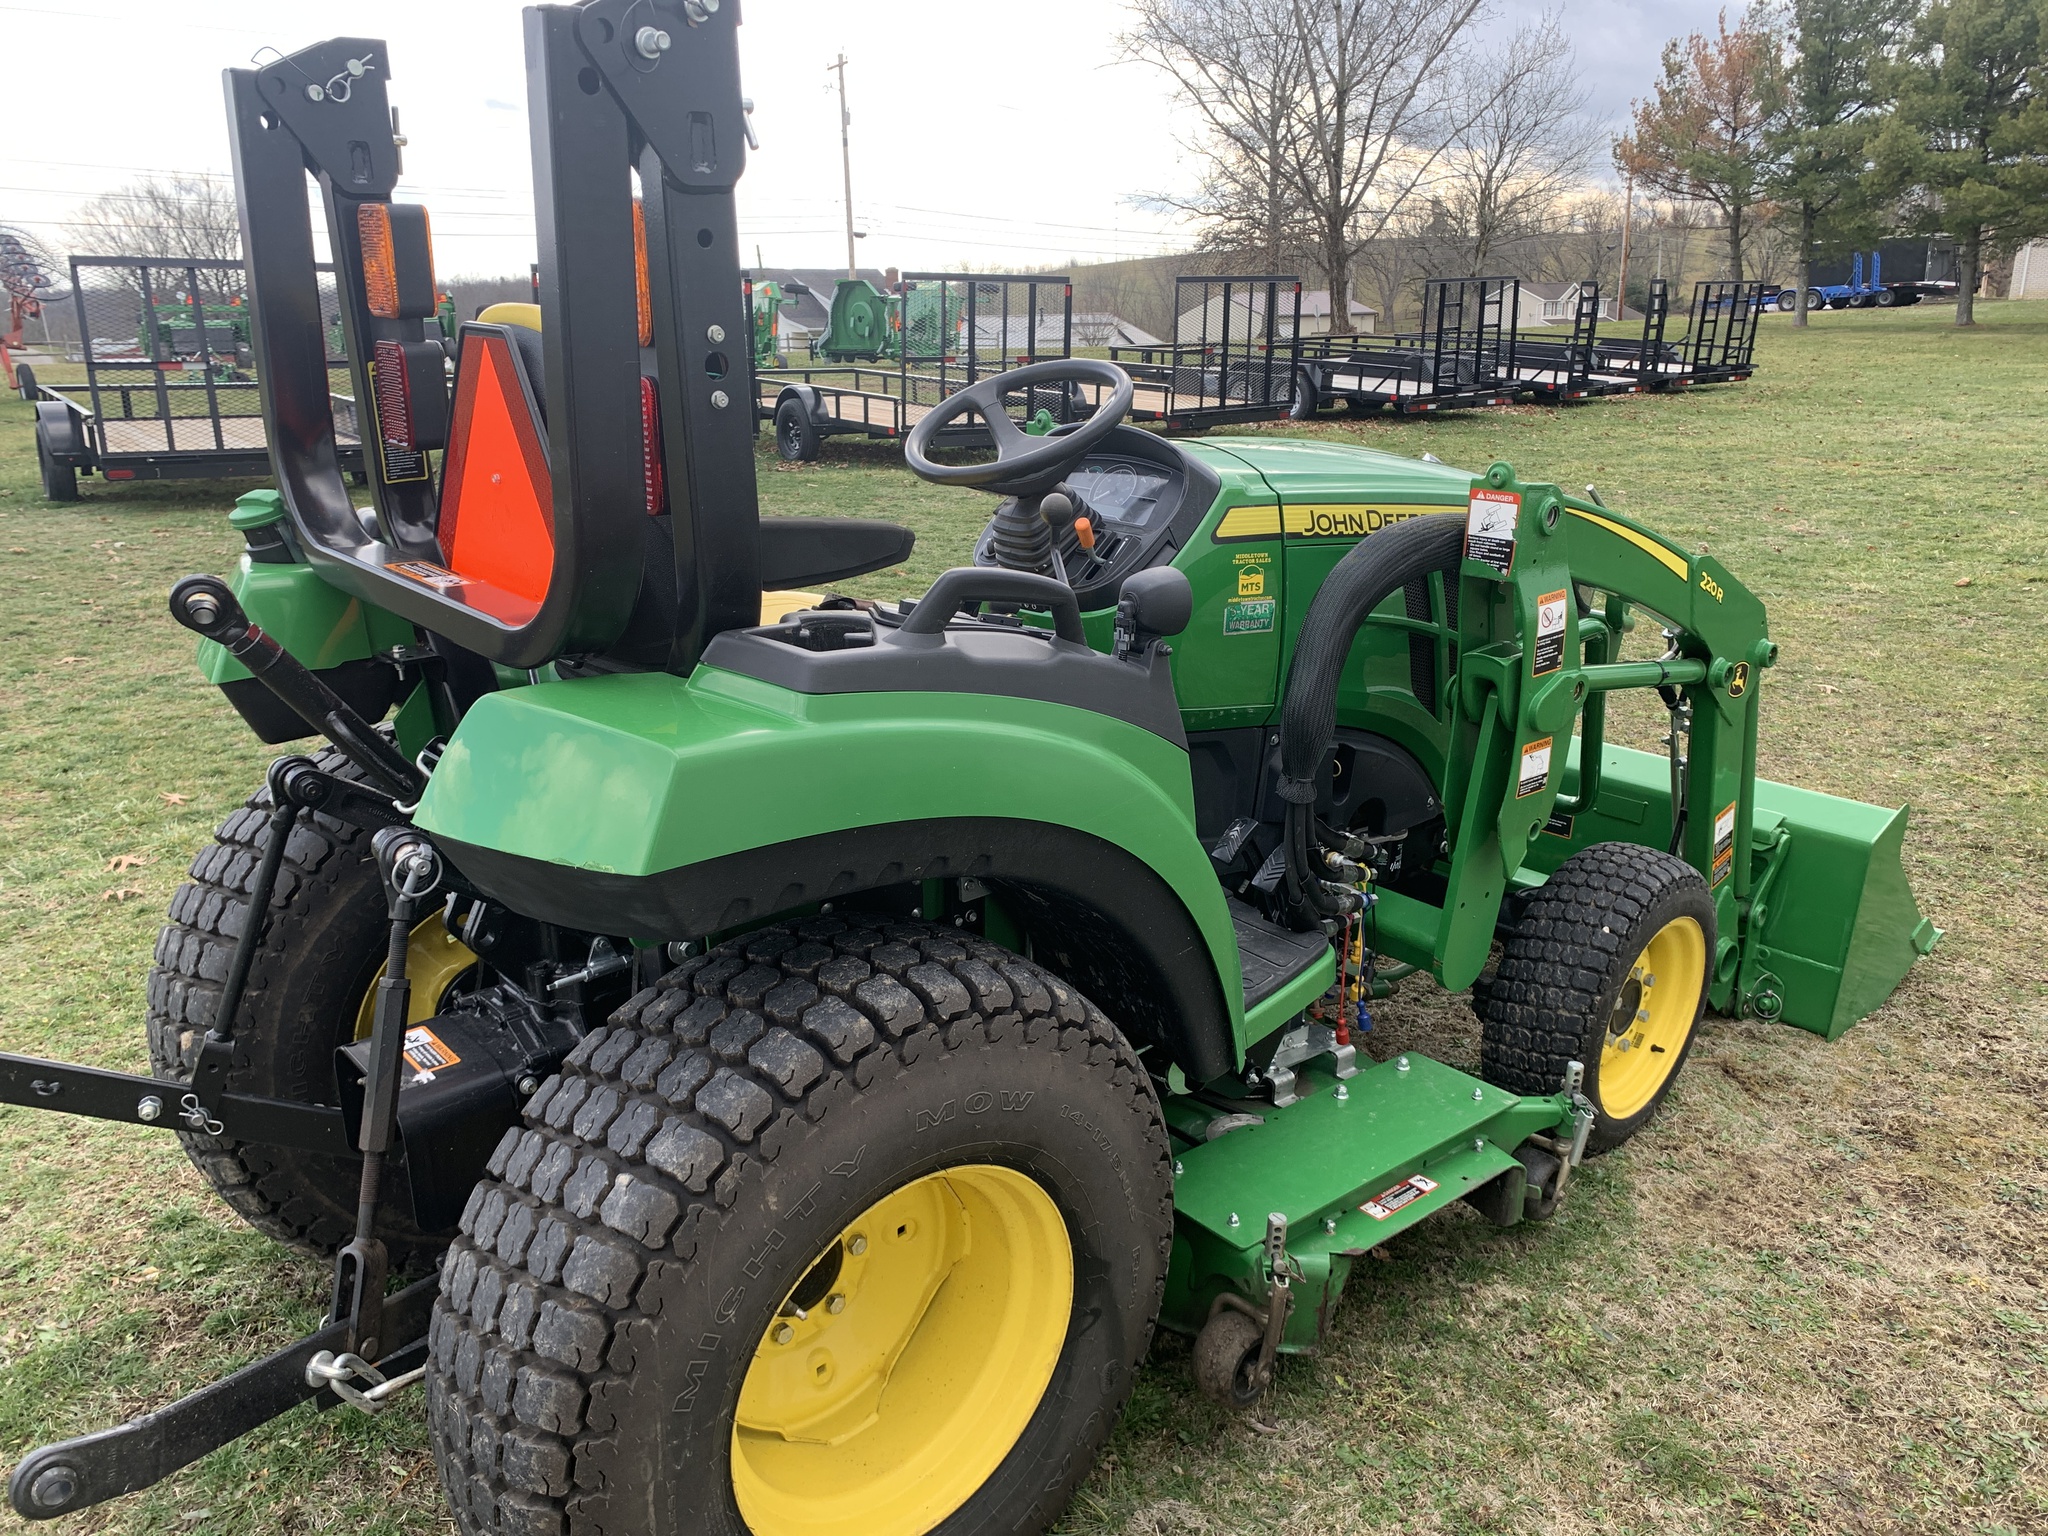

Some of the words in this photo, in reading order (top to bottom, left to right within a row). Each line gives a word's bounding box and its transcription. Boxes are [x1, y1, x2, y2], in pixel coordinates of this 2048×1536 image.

[1486, 493, 1514, 502] DANGER
[1304, 510, 1364, 533] JOHN
[1241, 582, 1261, 592] MTS
[1700, 570, 1724, 604] 220R
[1544, 590, 1565, 602] WARNING
[1229, 618, 1270, 630] WARRANTY
[916, 1090, 1034, 1132] MOW
